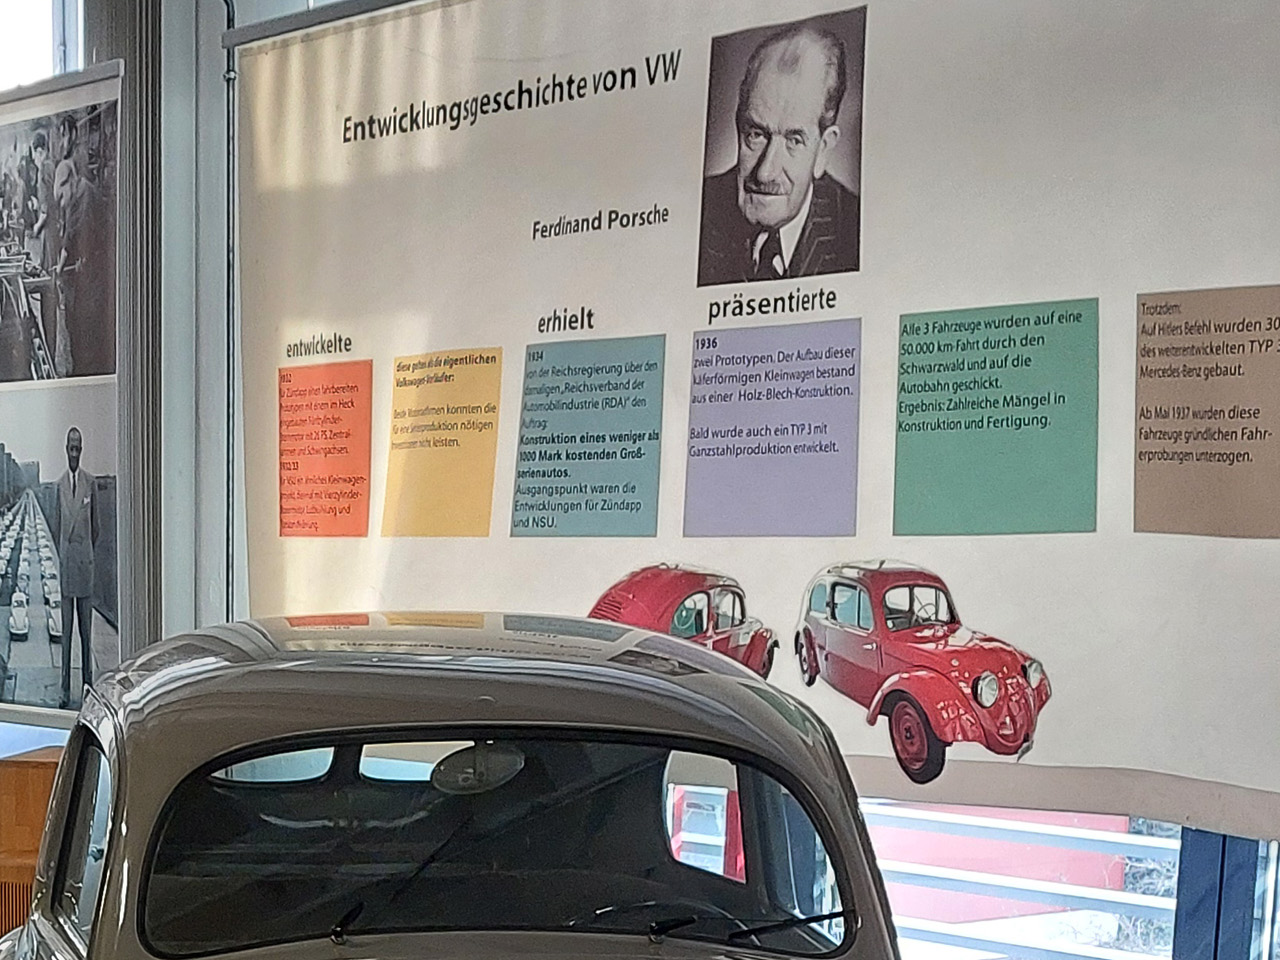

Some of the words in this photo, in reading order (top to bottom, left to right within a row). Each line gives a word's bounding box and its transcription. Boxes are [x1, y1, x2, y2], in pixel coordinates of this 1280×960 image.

[341, 74, 587, 144] Entwicklungsgeschichte
[592, 63, 637, 94] von
[645, 49, 682, 86] VW
[531, 210, 602, 240] Ferdinand
[608, 205, 669, 230] Porsche
[708, 288, 837, 324] präsentierte
[538, 307, 594, 333] erhielt
[902, 323, 921, 336] Alle
[923, 322, 930, 335] 3
[932, 319, 982, 335] Fahrzeuge
[984, 315, 1031, 330] wurden
[1034, 311, 1055, 326] auf
[1058, 310, 1083, 324] eine
[1141, 322, 1156, 336] Auf
[1214, 317, 1261, 334] wurden
[286, 333, 352, 357] entwickelte
[695, 337, 718, 350] 1936
[982, 335, 1016, 350] durch
[1020, 333, 1045, 347] den
[1249, 338, 1273, 354] TYP
[443, 354, 496, 369] eigentlichen
[694, 355, 713, 368] zwei
[777, 351, 794, 363] Der
[796, 348, 822, 361] Aufbau
[824, 346, 856, 359] dieser
[900, 358, 965, 375] Schwarzwald
[967, 356, 987, 371] und
[989, 354, 1009, 369] auf
[1011, 354, 1032, 368] die
[551, 363, 622, 378] Reichsregierung
[624, 361, 642, 373] über
[644, 360, 658, 371] den
[764, 368, 814, 383] Kleinwagen
[816, 364, 856, 379] bestand
[1204, 361, 1245, 380] gebaut.
[632, 378, 645, 390] der
[899, 379, 950, 395] Autobahn
[952, 377, 1002, 394] geschickt.
[631, 396, 646, 408] den
[692, 393, 706, 404] aus
[708, 391, 733, 403] einer
[946, 397, 999, 412] Zahlreiche
[1002, 392, 1051, 410] Mängel
[1054, 392, 1066, 405] in
[447, 404, 482, 415] konnten
[484, 403, 496, 414] die
[1192, 404, 1225, 420] wurden
[1228, 404, 1261, 420] diese
[460, 419, 493, 432] nötigen
[690, 427, 709, 440] Bald
[711, 425, 743, 438] wurde
[746, 424, 771, 437] auch
[774, 424, 789, 436] ein
[813, 422, 827, 434] mit
[898, 417, 962, 432] Konstruktion
[964, 415, 984, 430] und
[986, 414, 1051, 430] Fertigung.
[520, 433, 577, 445] Konstruktion
[579, 431, 606, 443] eines
[609, 429, 646, 444] weniger
[648, 429, 659, 441] als
[1139, 427, 1182, 444] Fahrzeuge
[1241, 426, 1273, 440] Fahr-
[538, 449, 563, 461] Mark
[565, 448, 617, 460] kostenden
[620, 446, 646, 459] Groß-
[689, 443, 791, 458] Ganzstahlproduktion
[1195, 449, 1253, 466] unterzogen.
[517, 467, 571, 479] serienautos.
[515, 482, 588, 497] Ausgangspunkt
[590, 483, 620, 494] waren
[622, 481, 636, 493] die
[514, 500, 582, 513] Entwicklungen
[585, 499, 599, 511] für
[600, 498, 642, 512] Zündapp
[513, 517, 530, 528] und
[532, 516, 557, 528] NSU.
